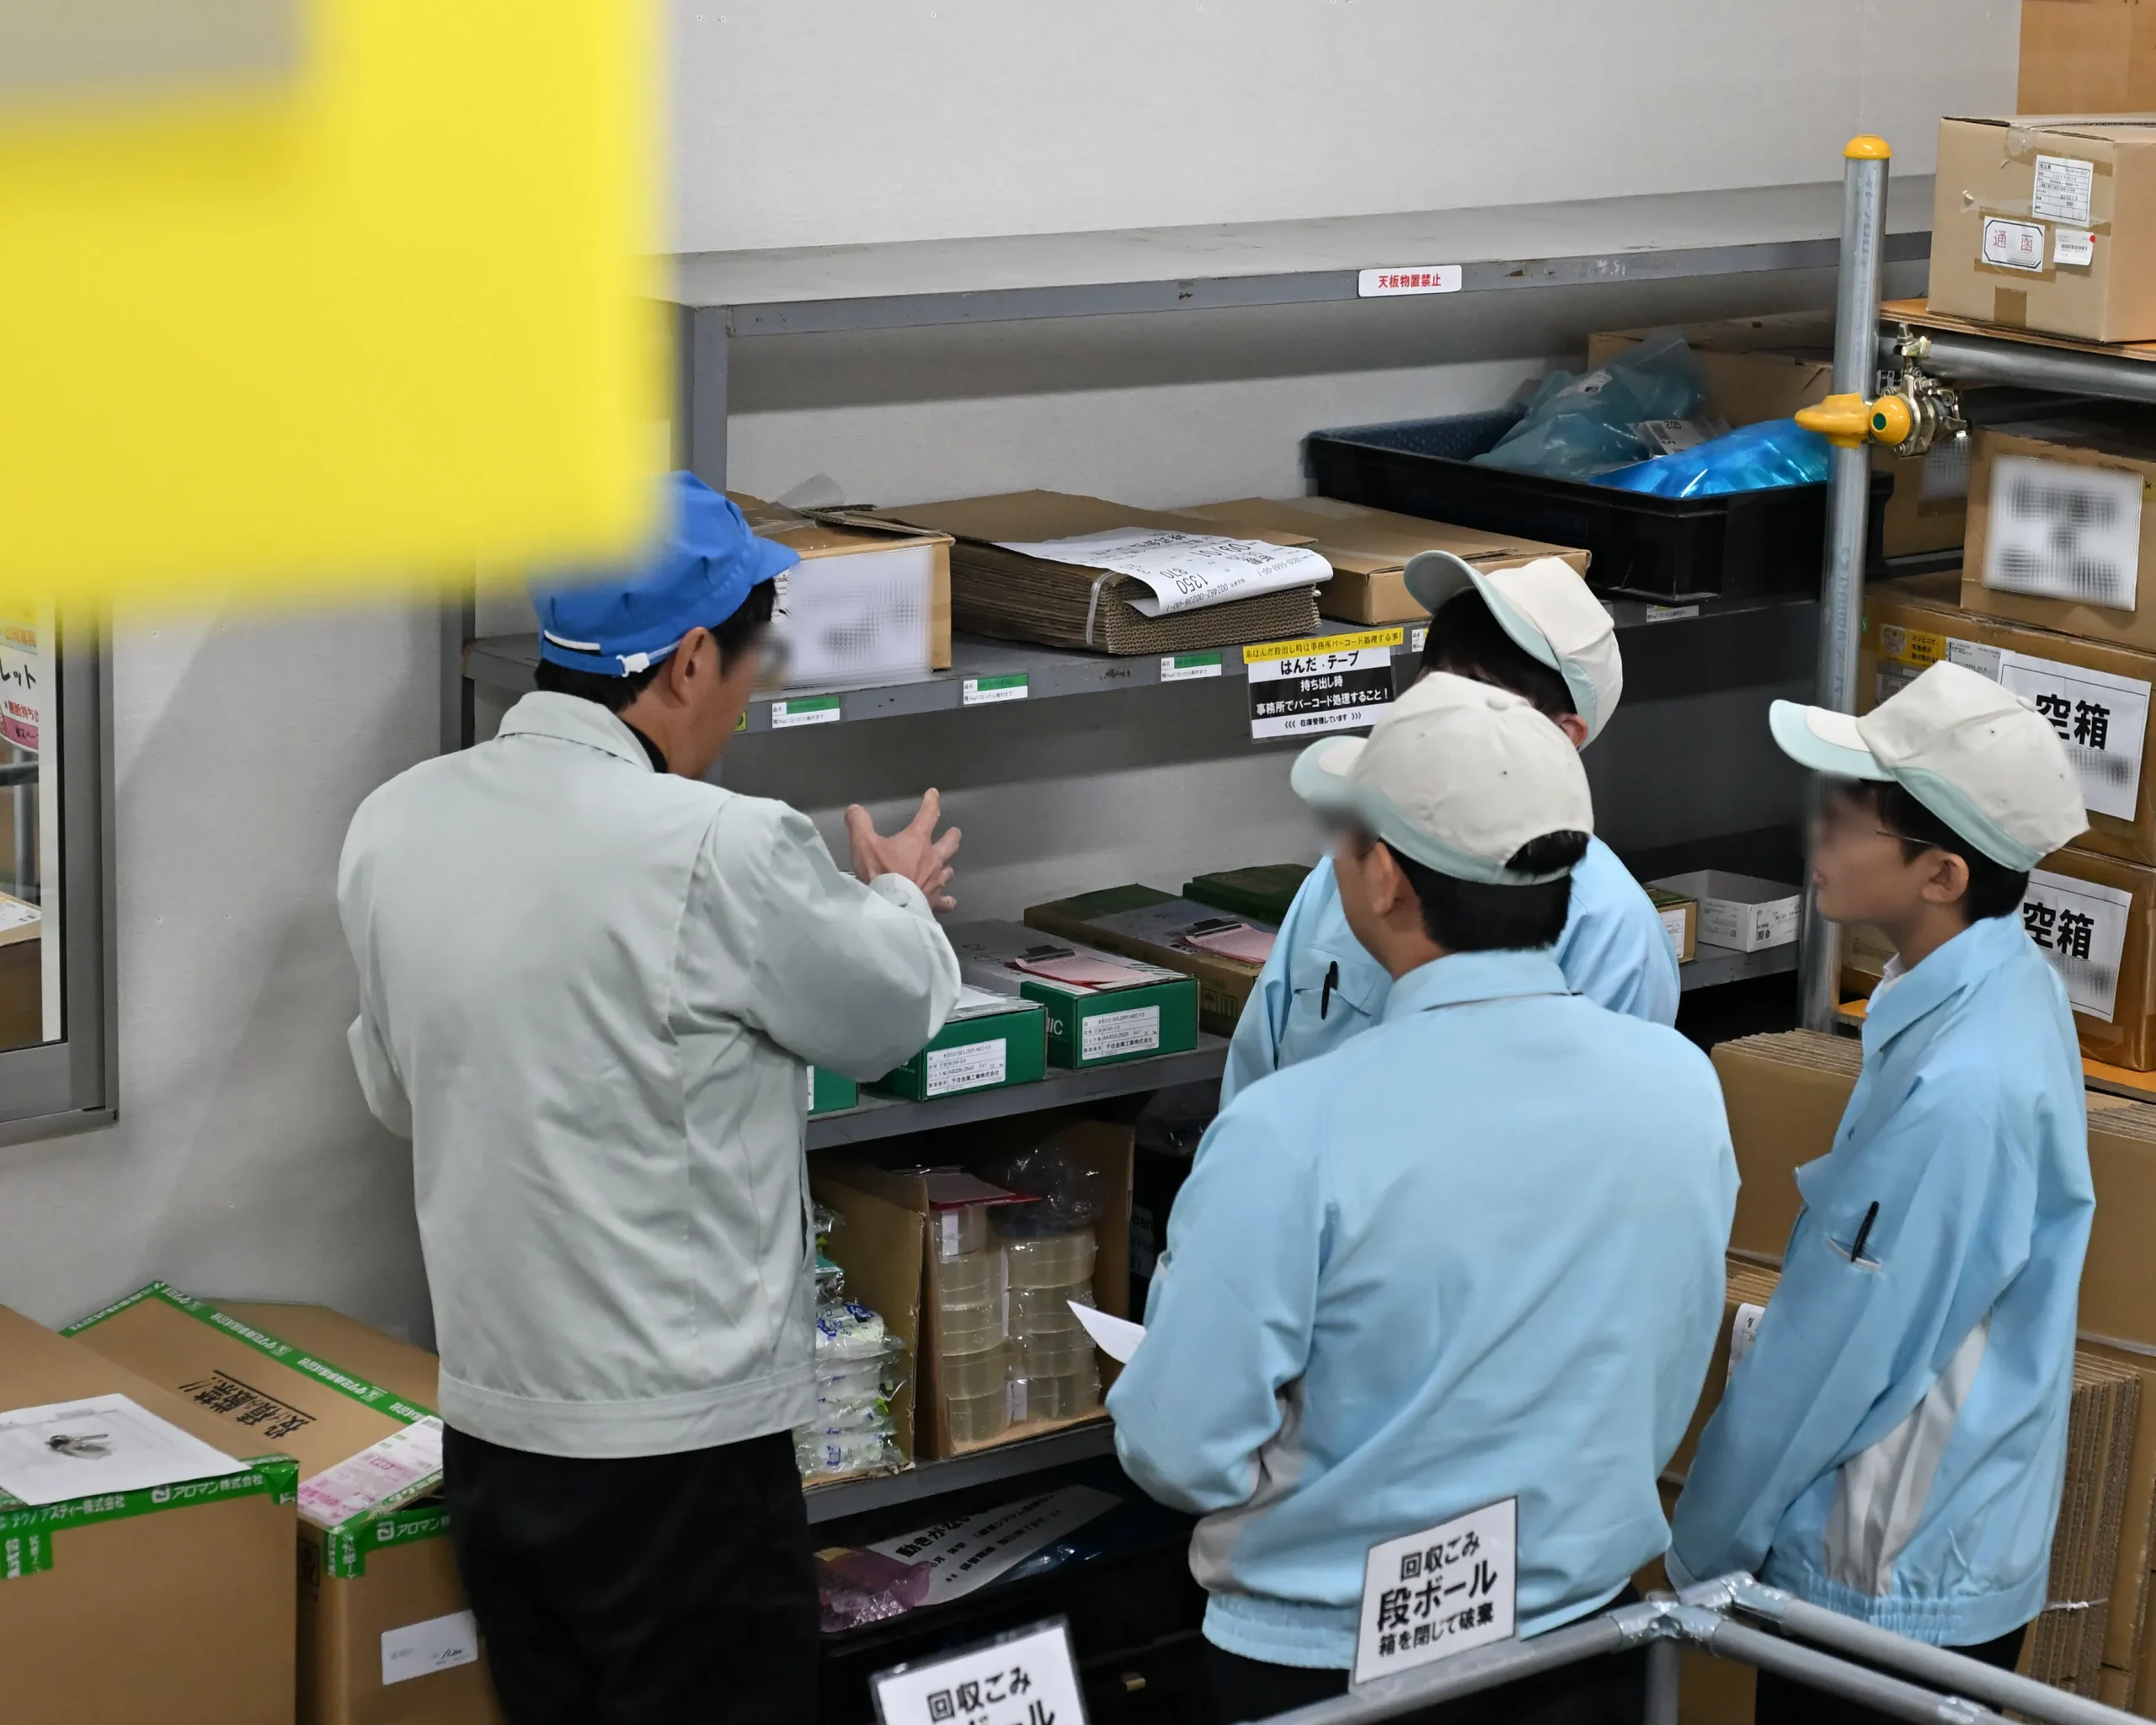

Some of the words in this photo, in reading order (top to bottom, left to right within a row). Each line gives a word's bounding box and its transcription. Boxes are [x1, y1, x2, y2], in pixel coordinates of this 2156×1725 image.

[1378, 273, 1441, 289] 天板物置禁止
[1176, 573, 1209, 595] 1350
[1300, 675, 1343, 692] 持ち出し時
[1256, 687, 1389, 715] 事務所でバーコード処理すること！
[1299, 714, 1348, 727] 在庫管理しています
[2036, 693, 2111, 750] 空箱
[2022, 902, 2095, 959] 空箱
[172, 1473, 264, 1499] アロマン株式会社
[1377, 1560, 1498, 1632] 段ボール
